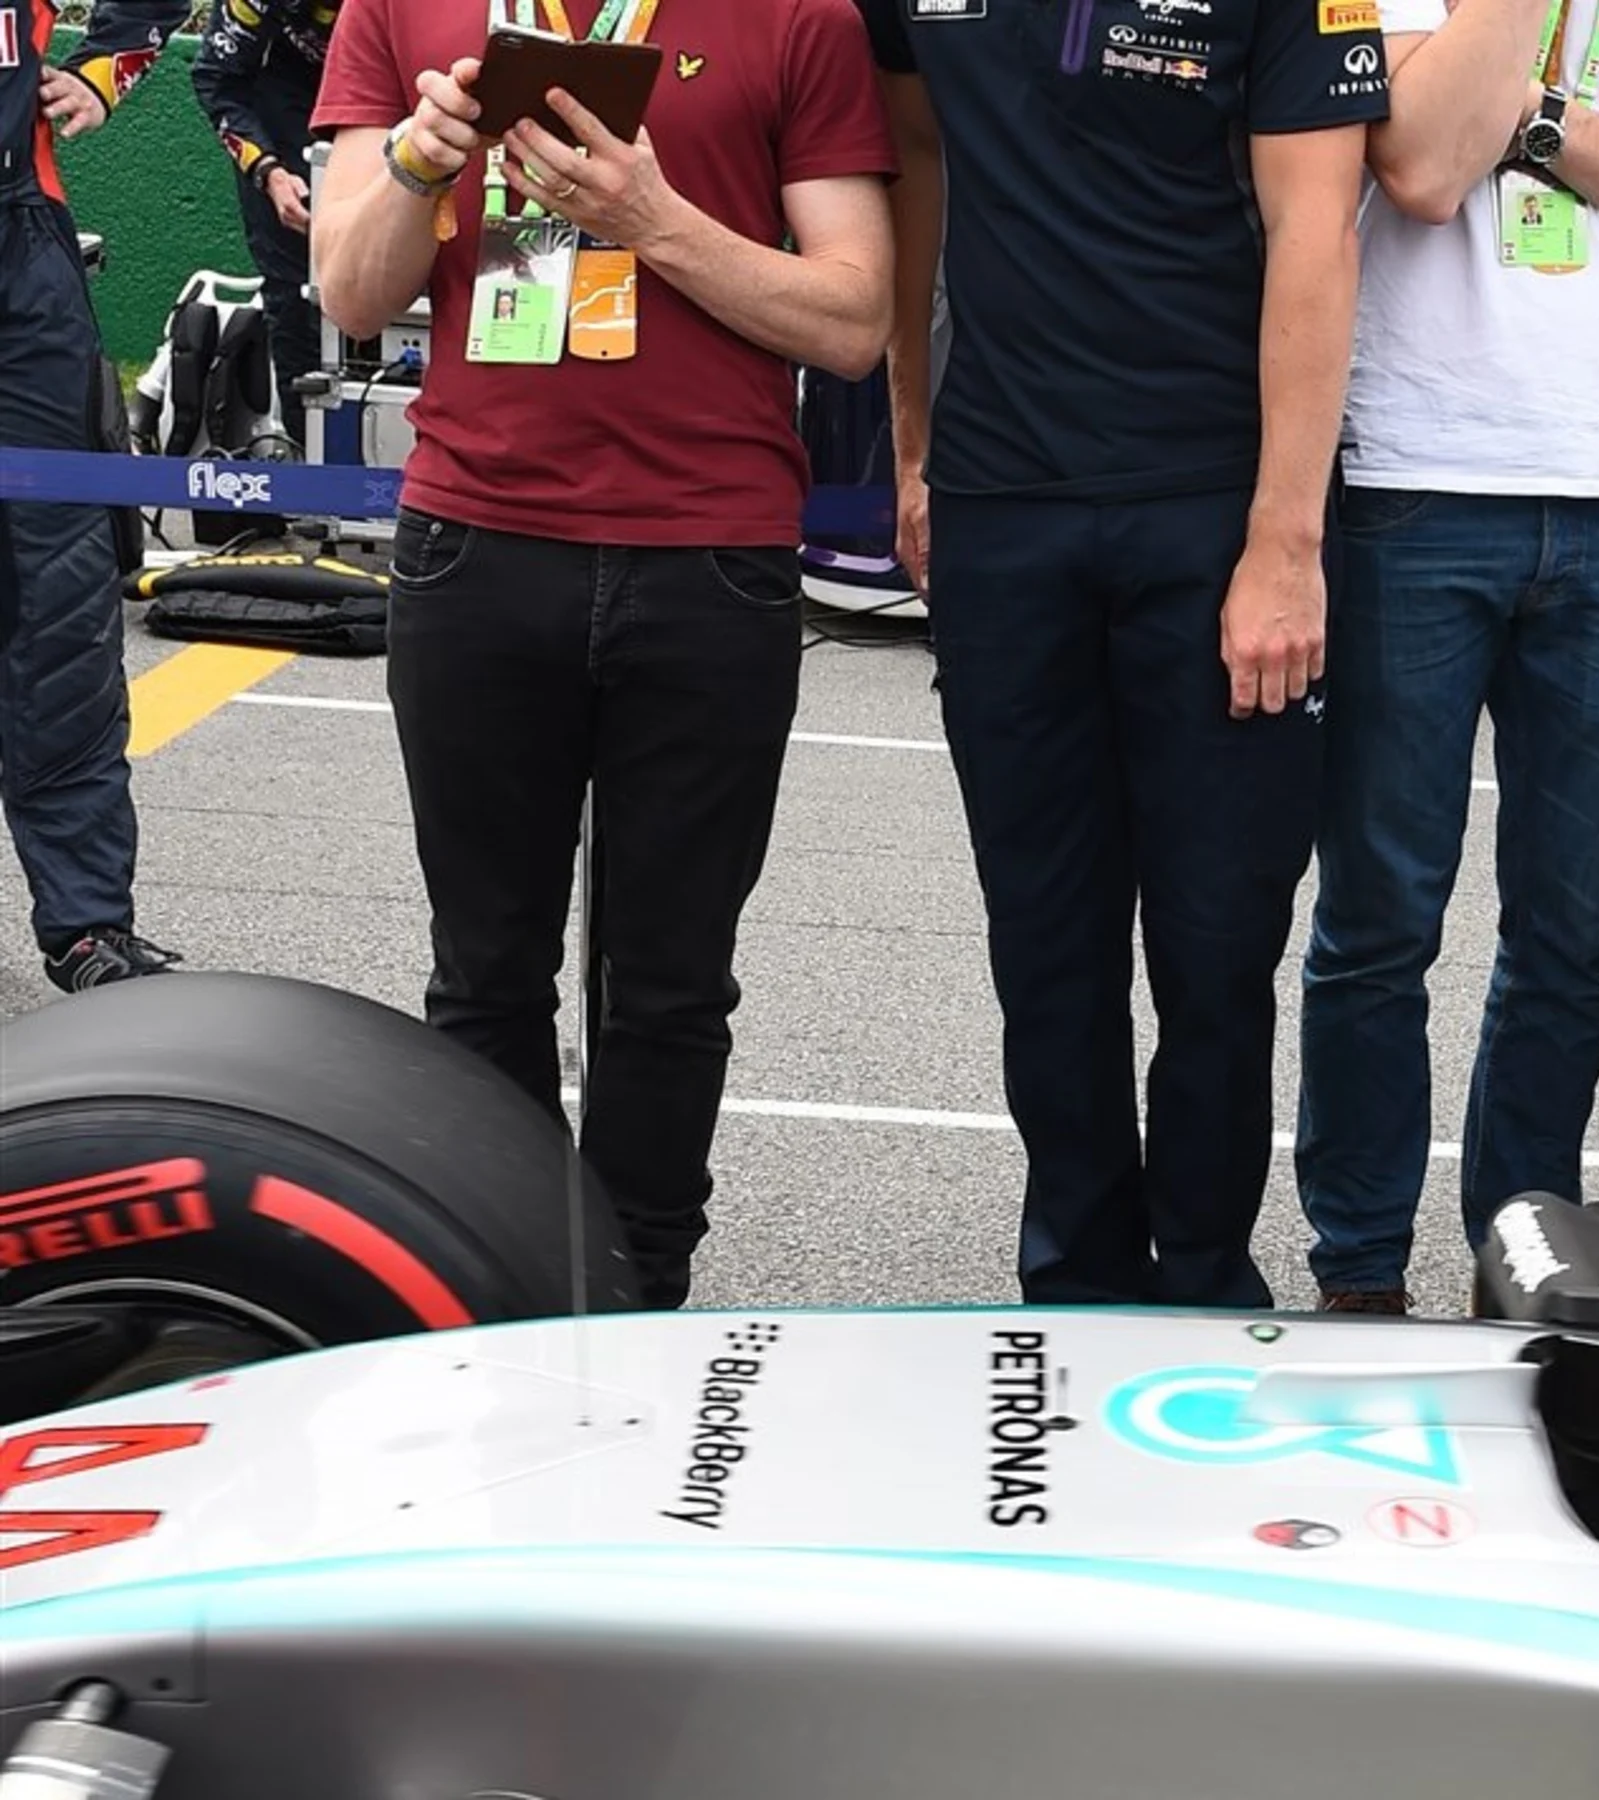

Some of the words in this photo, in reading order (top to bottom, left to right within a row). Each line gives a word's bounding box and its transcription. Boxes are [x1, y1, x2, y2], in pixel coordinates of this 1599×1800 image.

[188, 462, 272, 508] flex
[660, 1358, 761, 1529] BlackBerry
[989, 1331, 1049, 1527] PETRONAS
